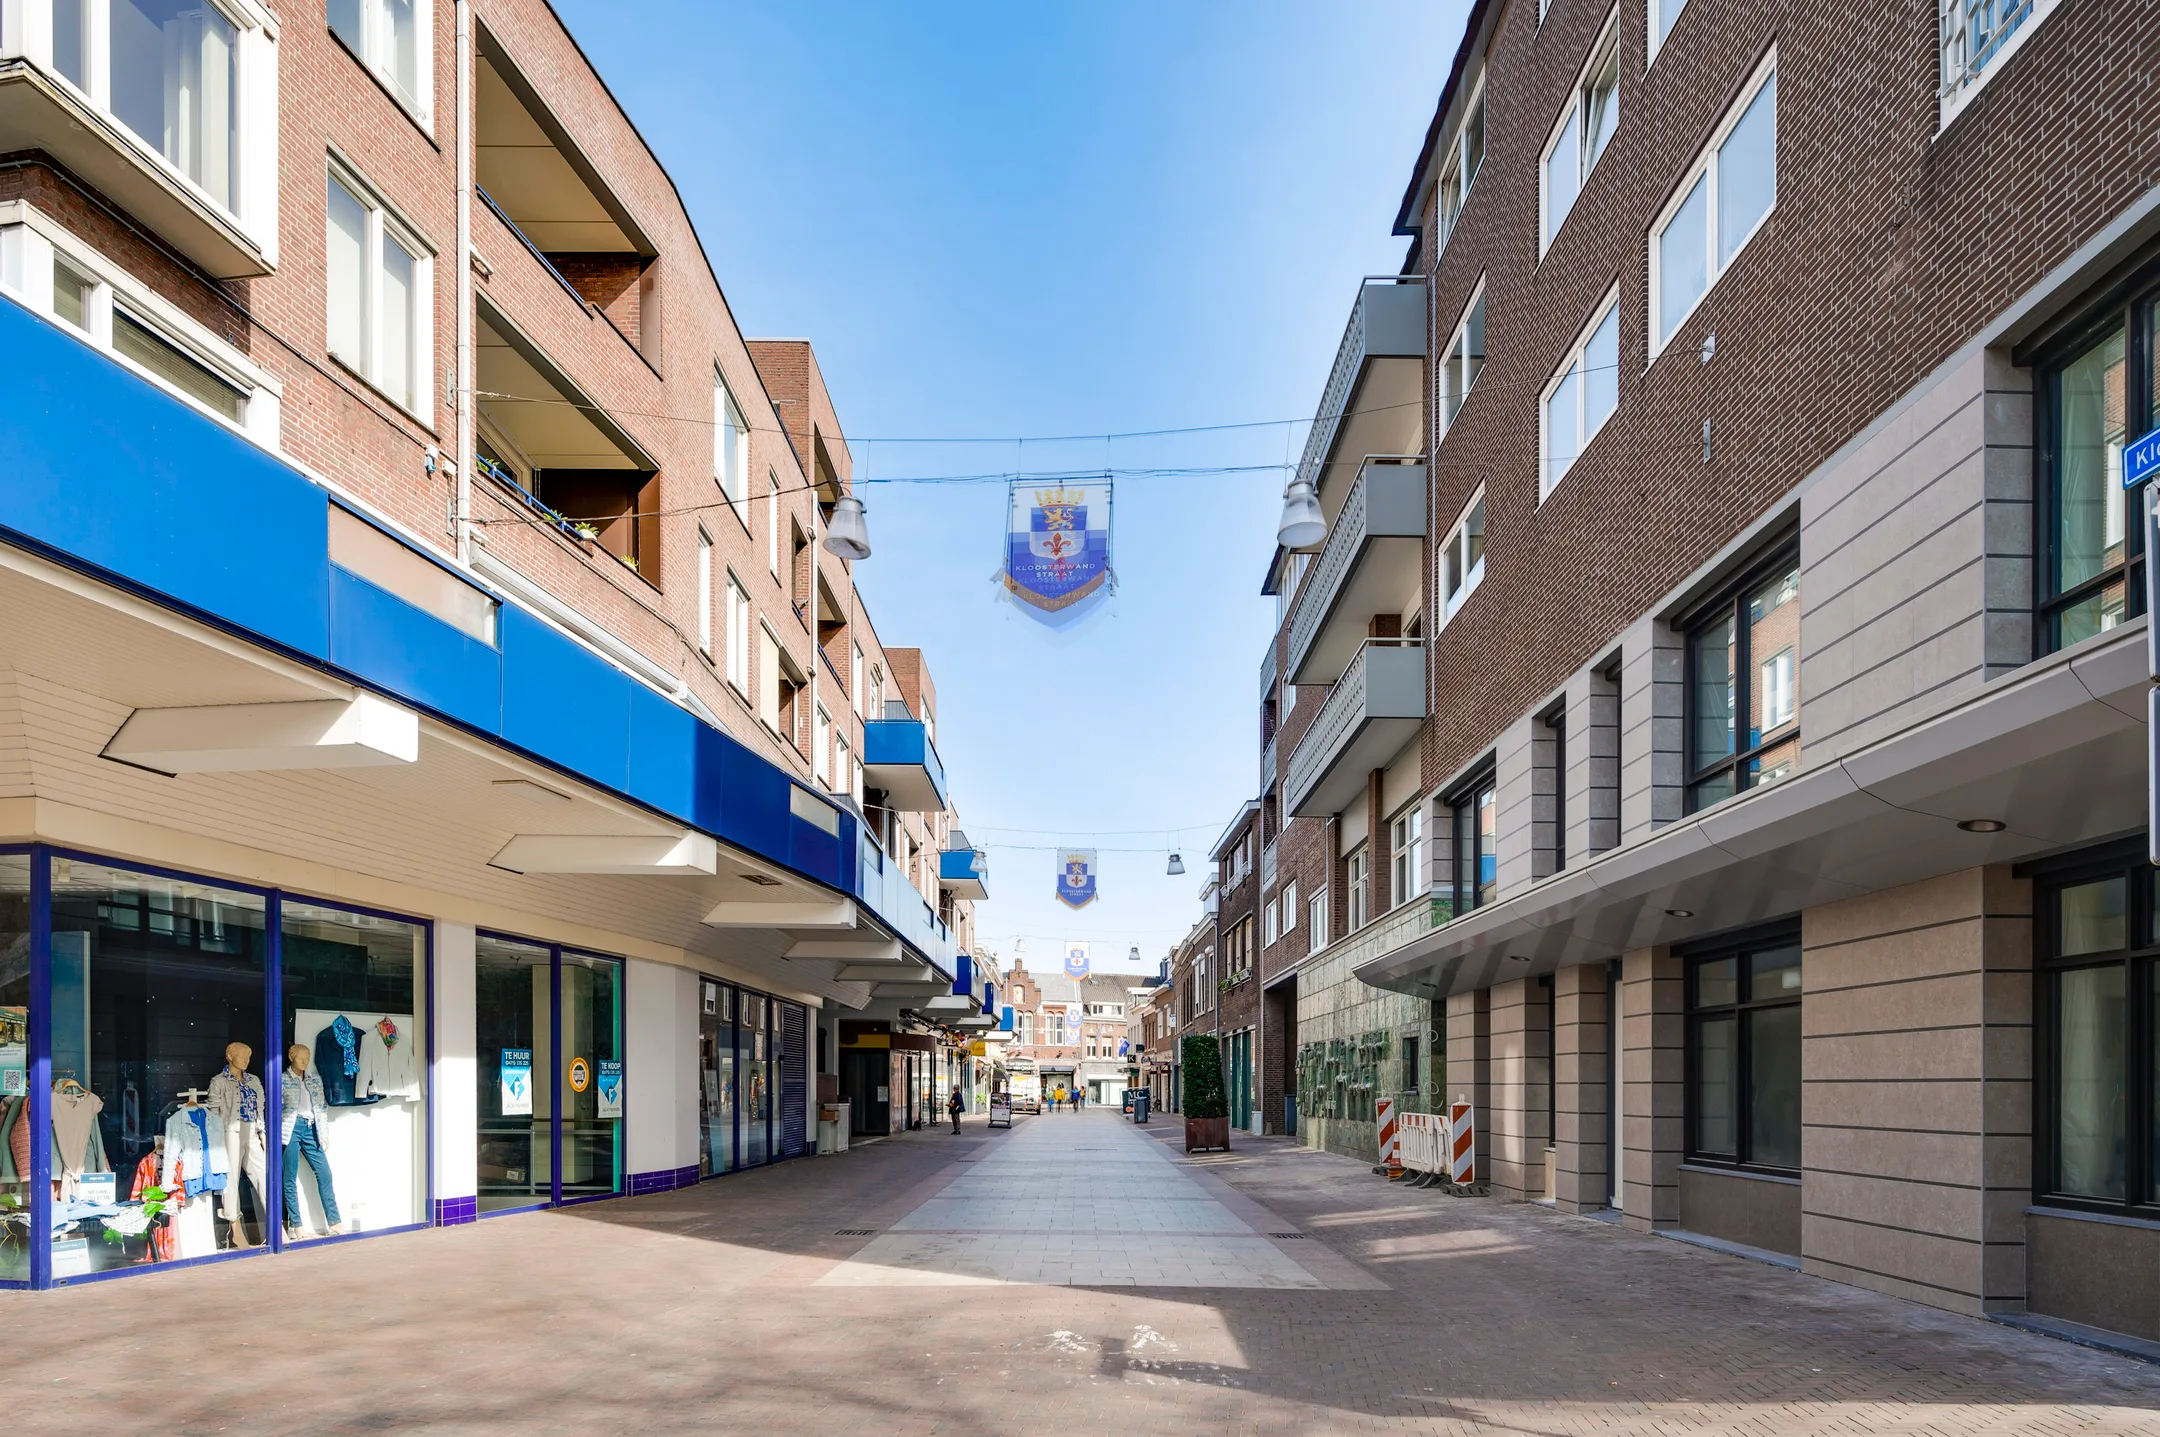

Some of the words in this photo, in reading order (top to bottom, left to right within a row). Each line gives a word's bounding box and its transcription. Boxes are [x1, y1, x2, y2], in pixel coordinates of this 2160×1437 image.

[1015, 563, 1096, 571] KLOOSTERWAND
[504, 1051, 512, 1060] TE
[512, 1051, 530, 1060] HUUR
[601, 1062, 607, 1070] TE
[607, 1062, 621, 1070] KOOP
